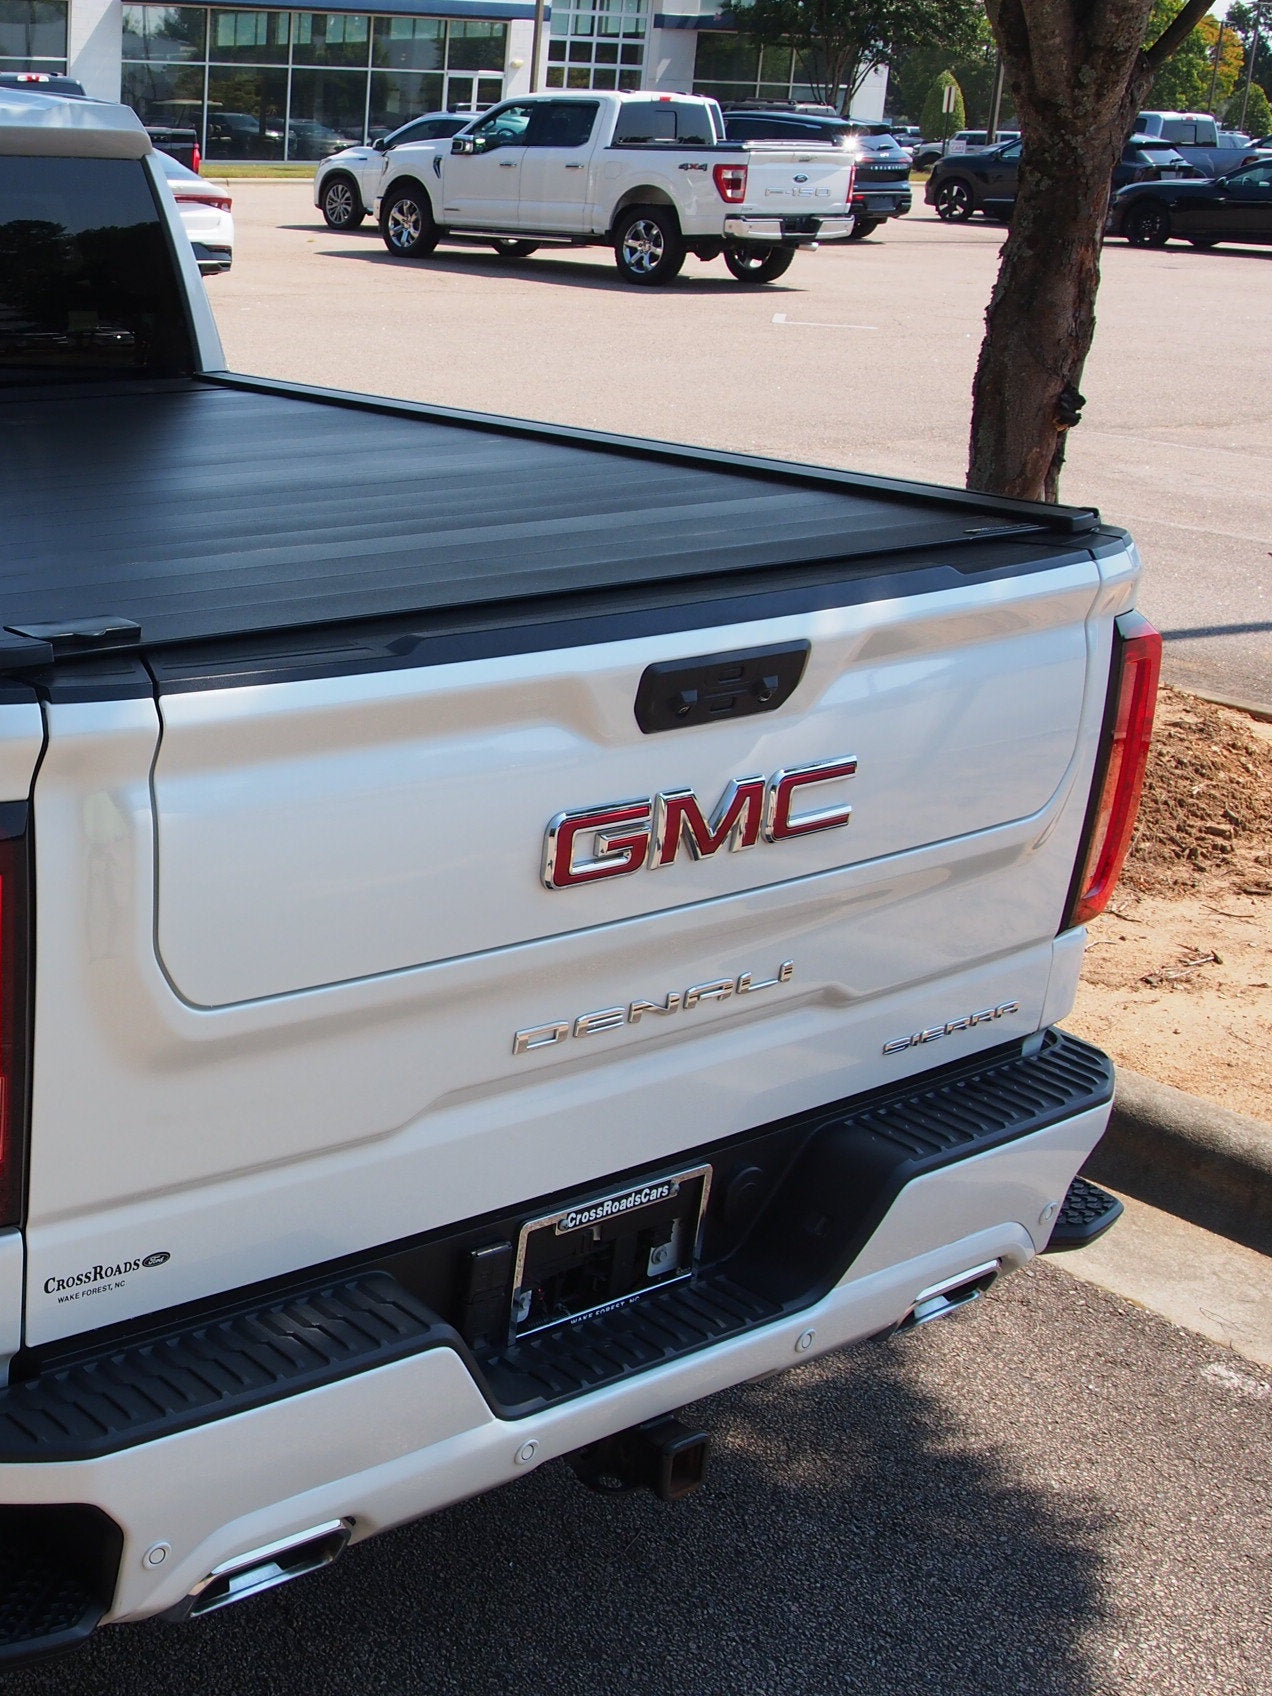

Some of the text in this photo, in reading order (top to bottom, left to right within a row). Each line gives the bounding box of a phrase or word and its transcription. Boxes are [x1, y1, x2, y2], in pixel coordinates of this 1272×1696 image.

[765, 187, 830, 197] F-150
[539, 754, 858, 890] GMC
[513, 959, 794, 1055] DENALI
[882, 1000, 1020, 1055] SIERRA
[567, 1185, 669, 1228] CrossRoadsCars
[57, 1280, 126, 1304] WAKE FOREST, NC
